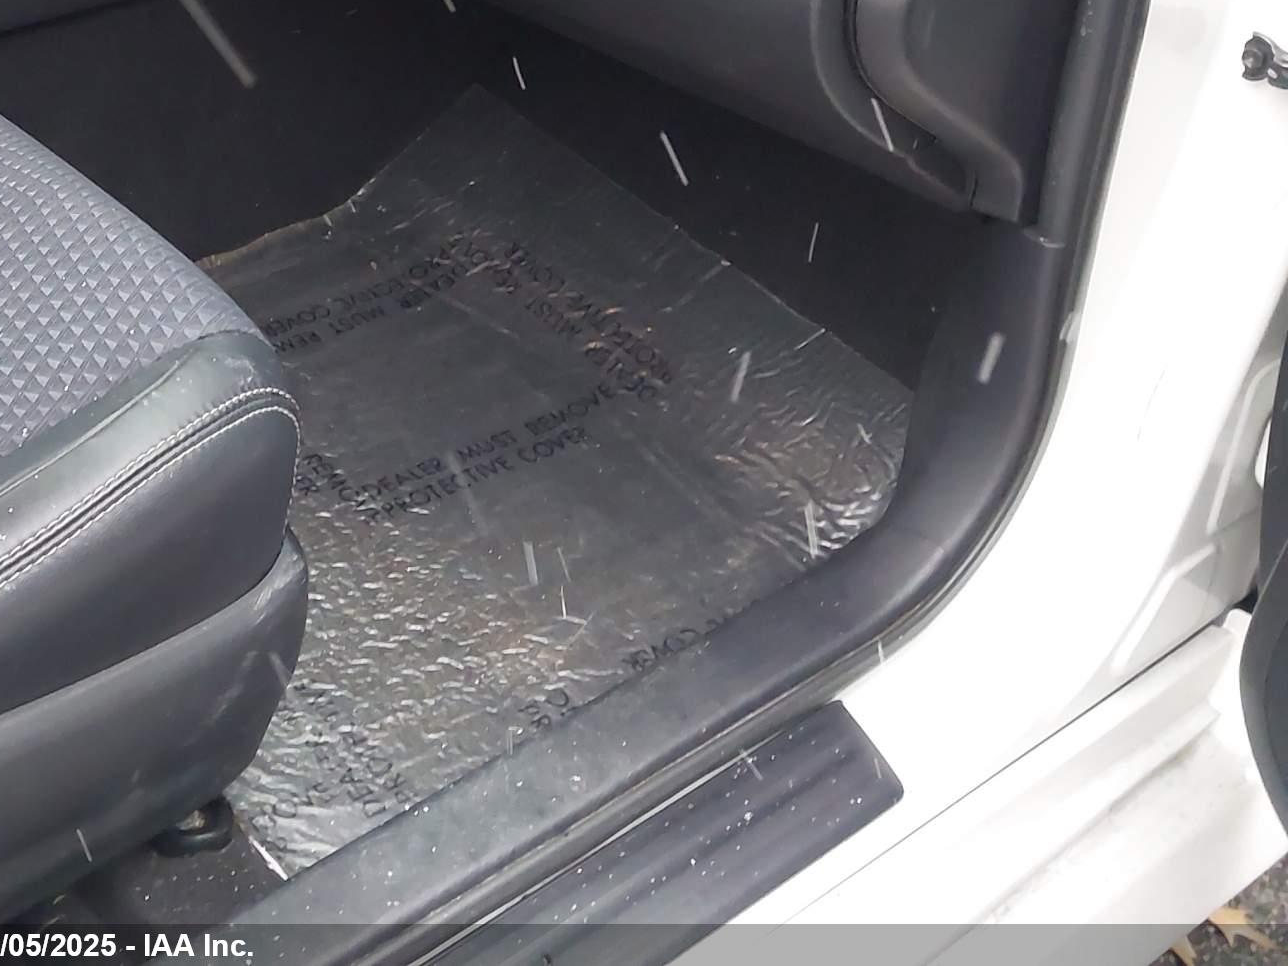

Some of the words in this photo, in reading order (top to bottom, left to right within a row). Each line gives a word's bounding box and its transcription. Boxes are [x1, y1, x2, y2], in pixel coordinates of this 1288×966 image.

[456, 429, 518, 463] MUST
[523, 382, 617, 437] REMOVE
[380, 455, 514, 519] PROTECTIVE
[516, 426, 586, 465] COVER
